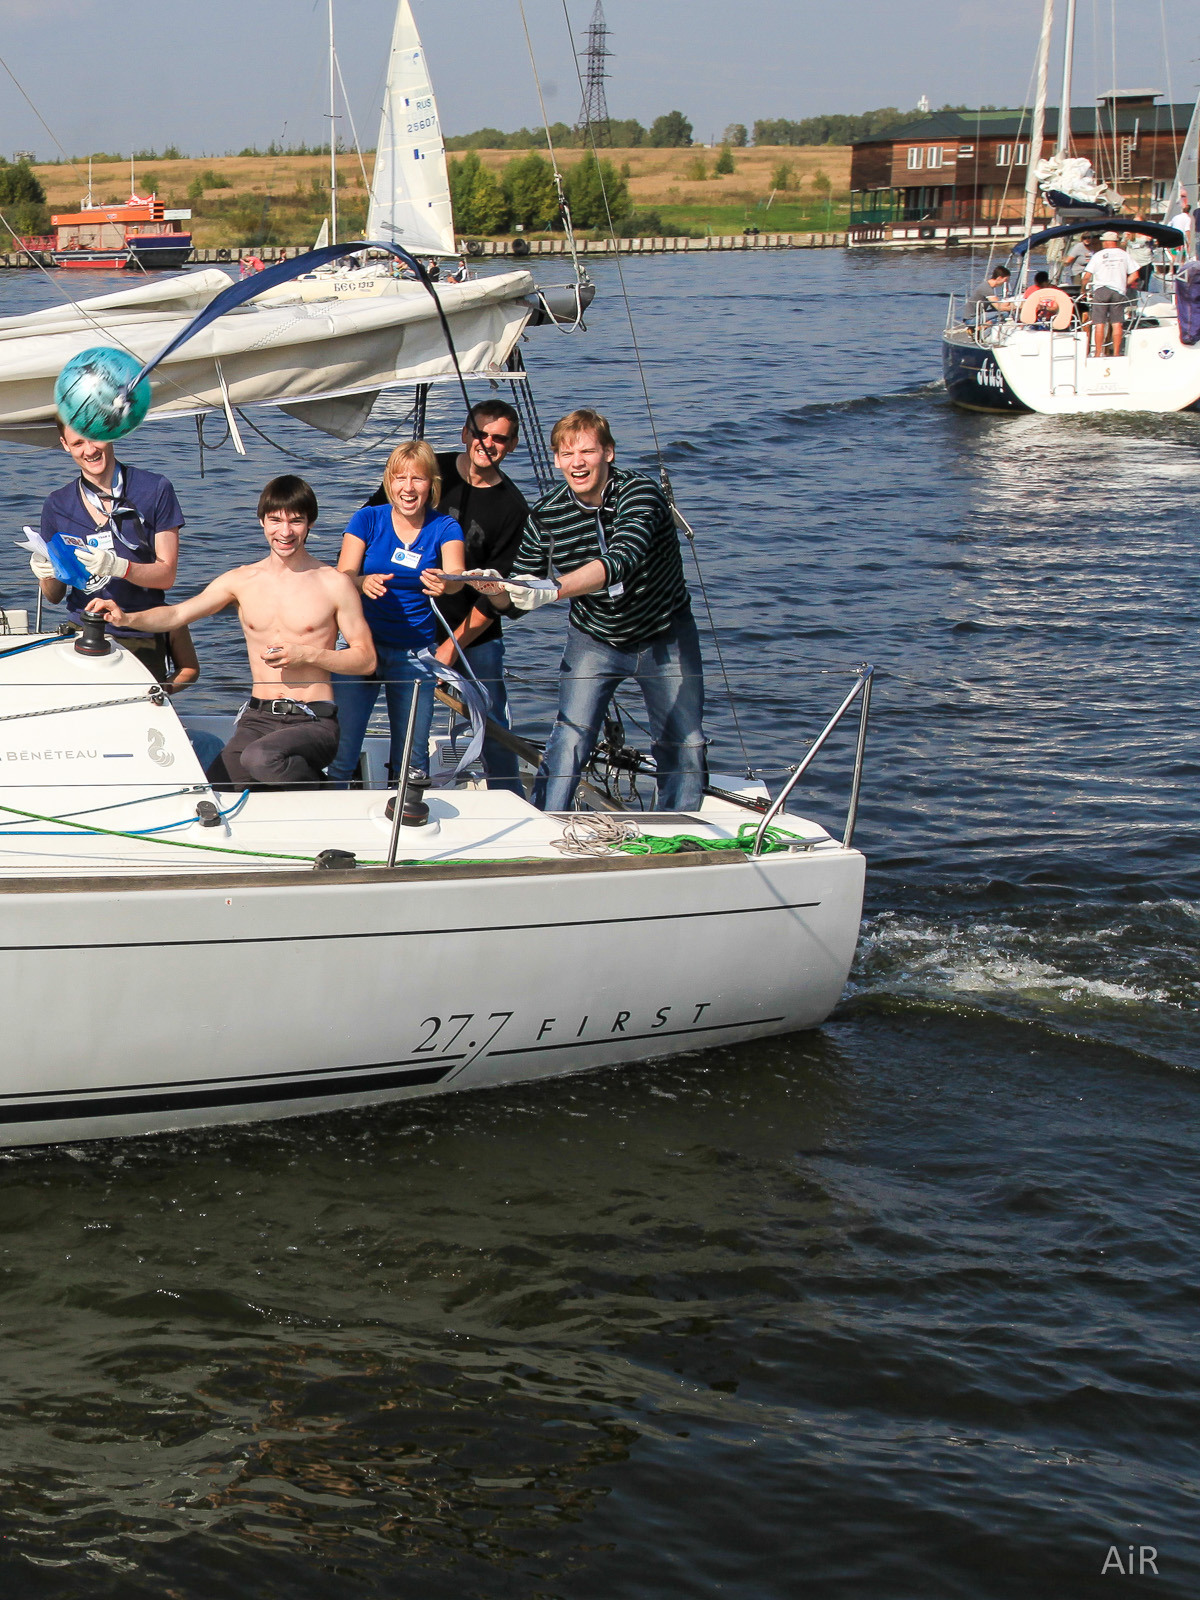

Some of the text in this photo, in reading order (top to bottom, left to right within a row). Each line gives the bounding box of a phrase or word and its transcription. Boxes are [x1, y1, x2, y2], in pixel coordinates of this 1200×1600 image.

[416, 98, 432, 111] RUS
[407, 115, 436, 133] 25607
[411, 1002, 711, 1083] 27.7 FIRST
